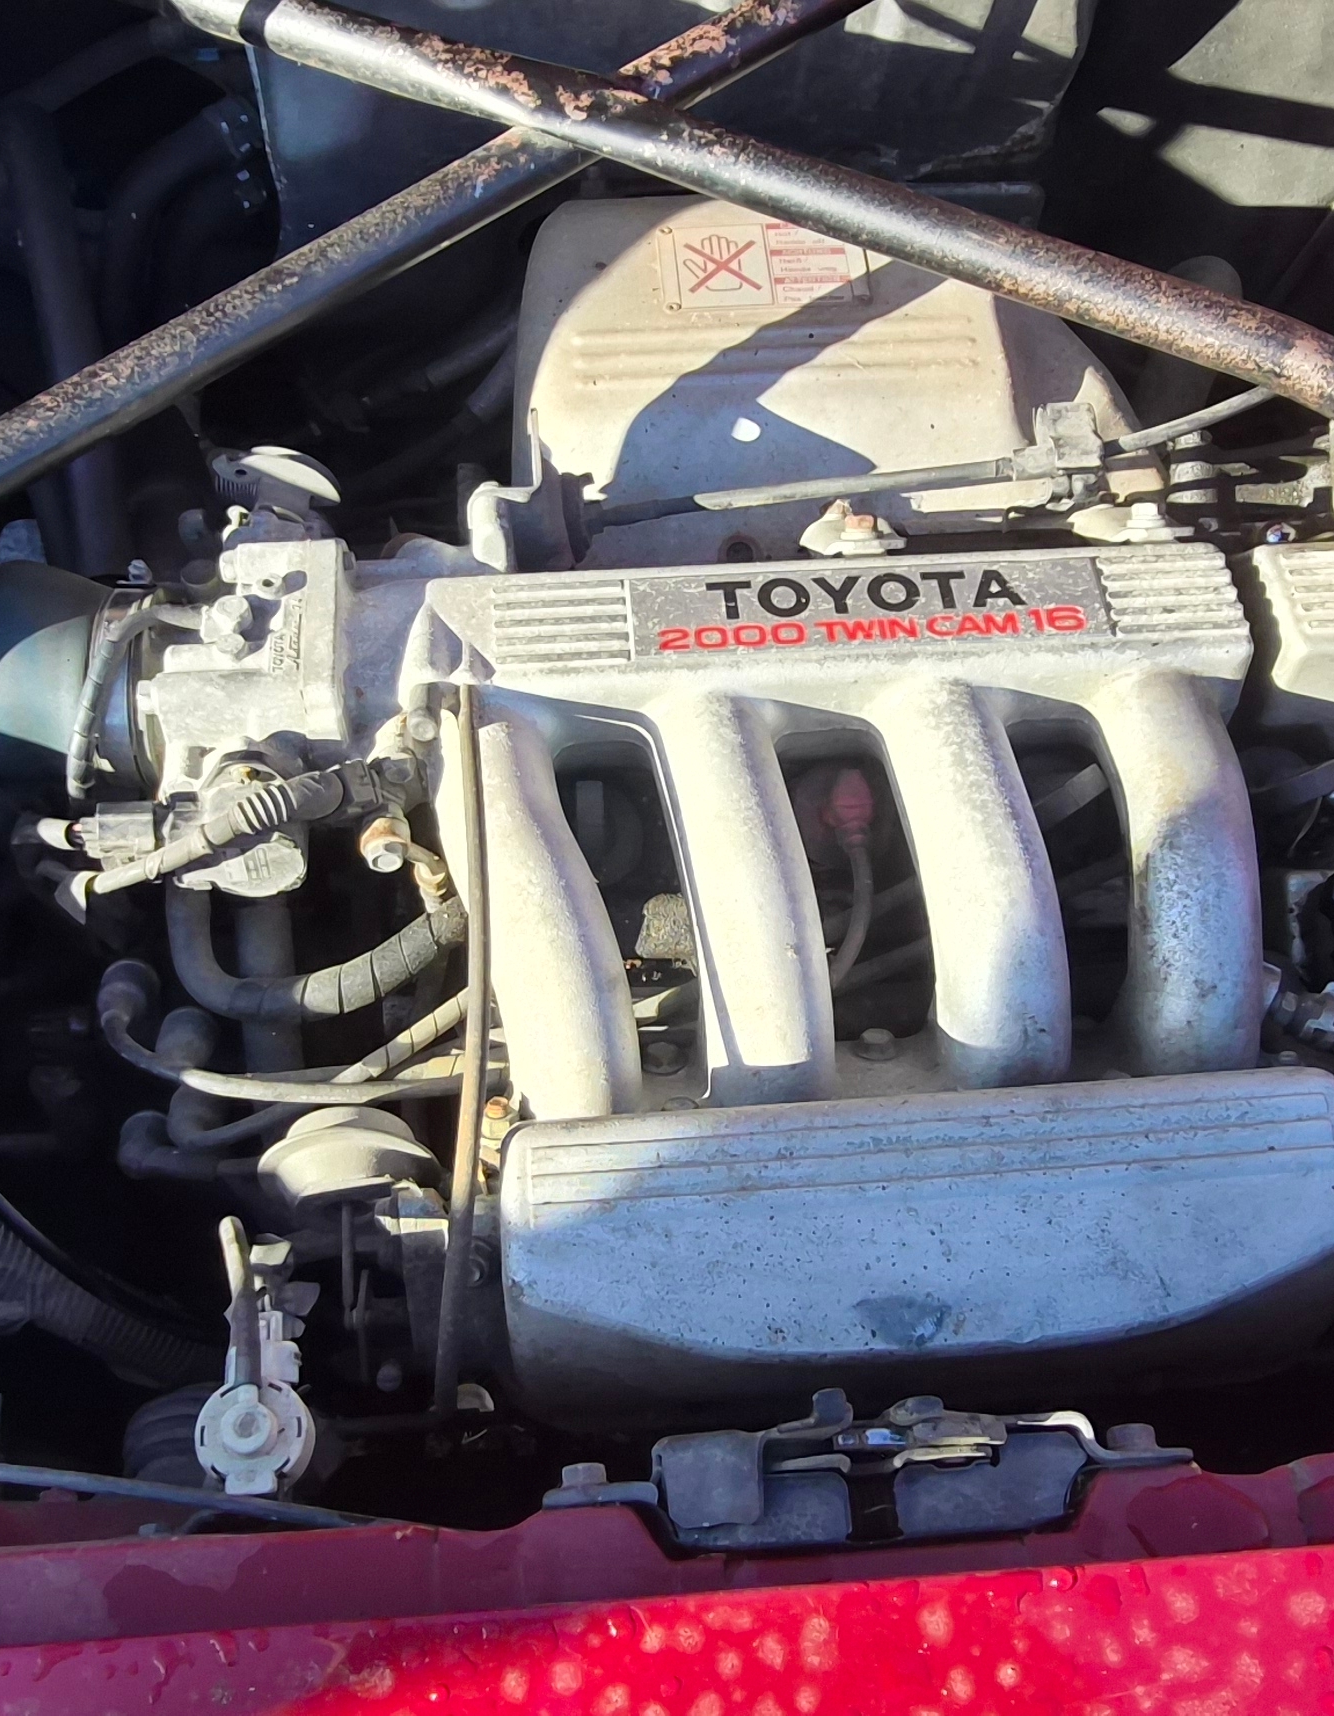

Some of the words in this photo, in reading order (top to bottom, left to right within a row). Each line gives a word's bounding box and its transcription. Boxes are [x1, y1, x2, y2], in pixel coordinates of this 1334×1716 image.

[705, 569, 1027, 620] TOYOTA
[657, 622, 809, 652] 2000
[814, 614, 919, 643] TWIN
[925, 610, 1021, 640] CAM
[1028, 605, 1088, 633] 16
[272, 633, 285, 673] TOYOTA
